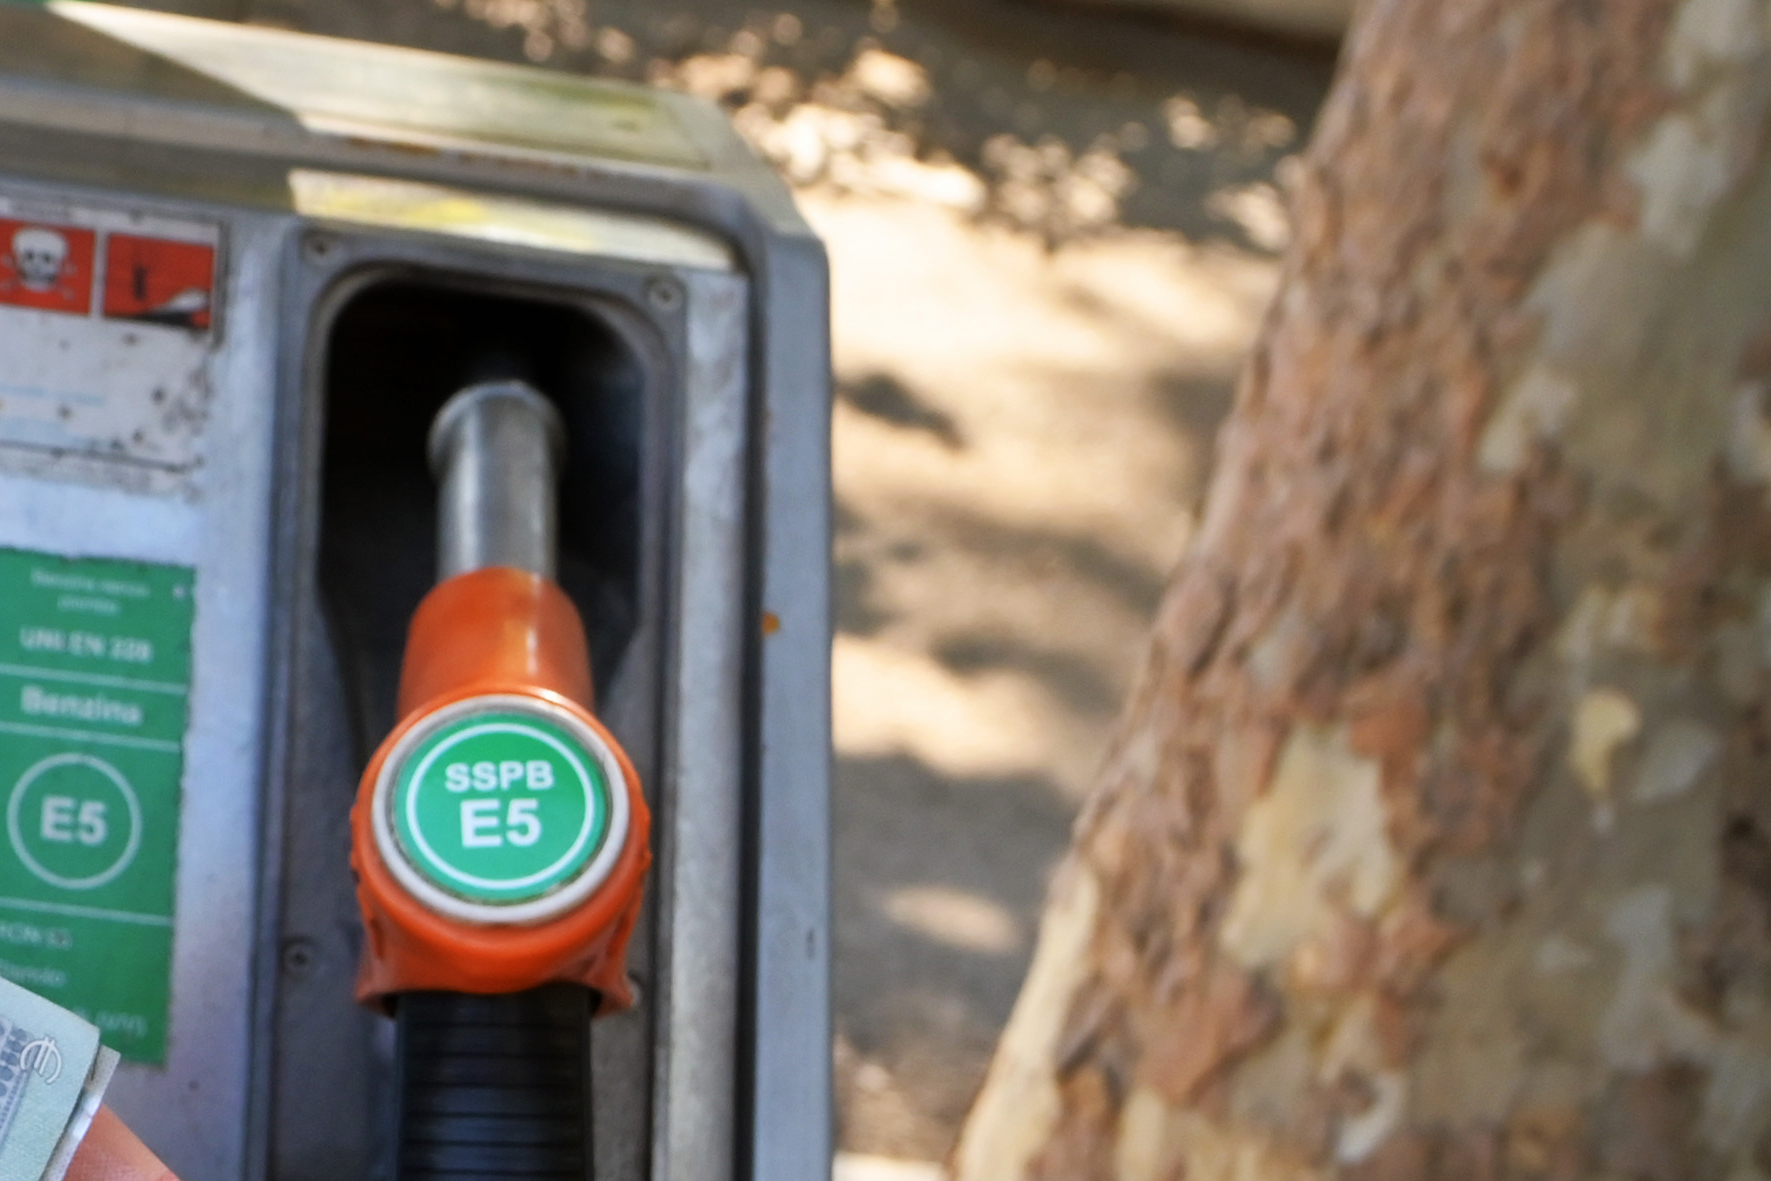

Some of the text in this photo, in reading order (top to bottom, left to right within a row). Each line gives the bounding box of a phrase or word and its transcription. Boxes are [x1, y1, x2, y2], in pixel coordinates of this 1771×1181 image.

[444, 760, 555, 792] SSPB
[39, 795, 108, 846] E5
[459, 798, 543, 848] E5
